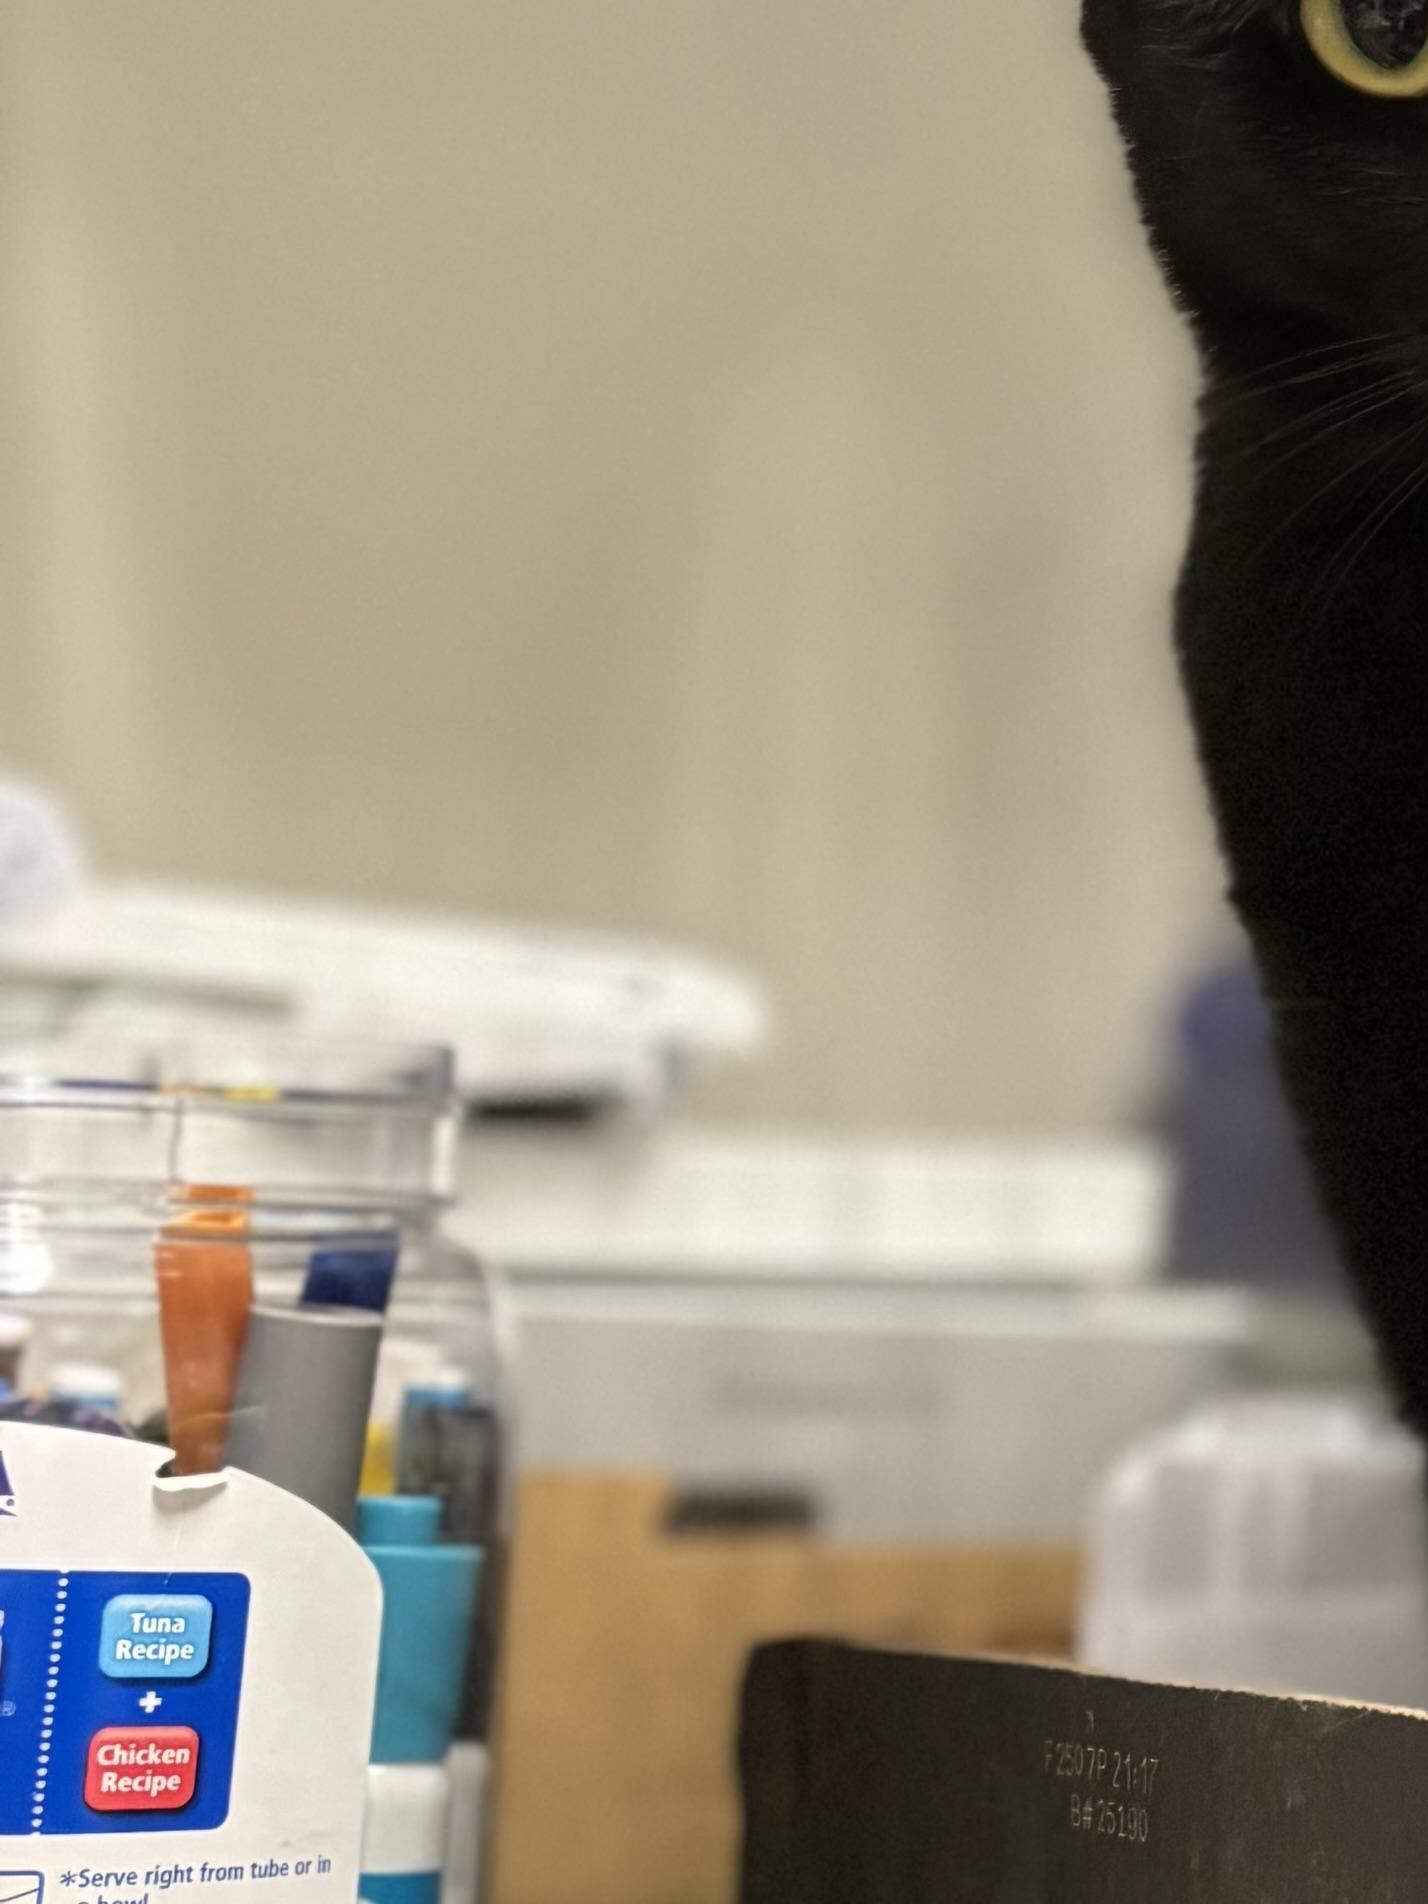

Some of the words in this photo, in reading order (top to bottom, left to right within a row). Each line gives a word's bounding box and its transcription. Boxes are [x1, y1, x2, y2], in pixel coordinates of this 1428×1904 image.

[130, 1612, 185, 1634] Tuna
[115, 1638, 195, 1665] Recipe
[97, 1743, 190, 1766] Chicken
[101, 1770, 181, 1797] Recipe
[145, 1864, 194, 1889] right
[200, 1862, 244, 1882] from
[251, 1858, 289, 1879] tube
[294, 1860, 312, 1875] or
[317, 1854, 331, 1874] in
